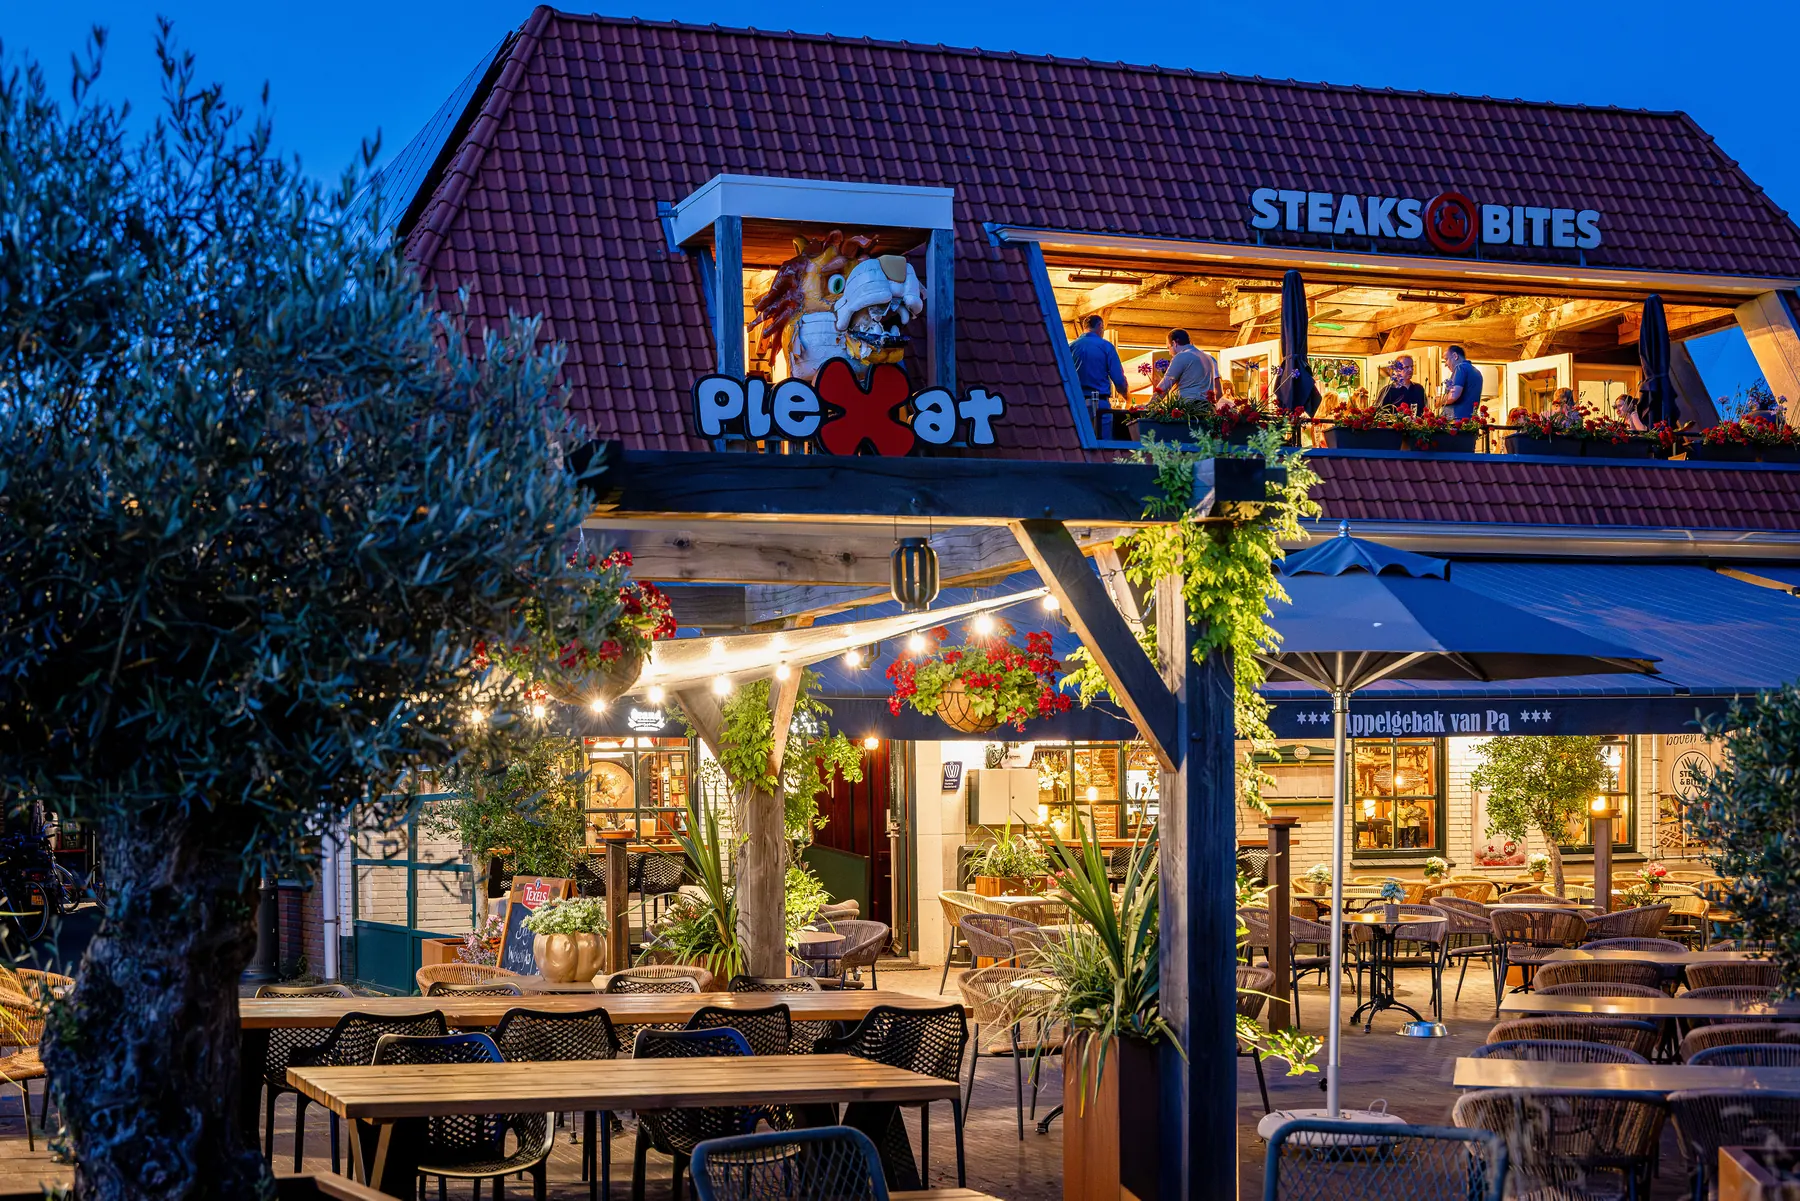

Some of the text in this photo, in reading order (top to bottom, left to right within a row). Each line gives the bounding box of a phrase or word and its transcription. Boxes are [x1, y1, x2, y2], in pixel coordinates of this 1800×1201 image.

[1249, 187, 1423, 239] STEAKS
[1482, 204, 1601, 249] BITES
[1450, 713, 1481, 733] van
[1486, 709, 1510, 732] Pa
[526, 886, 548, 901] TEXELS
